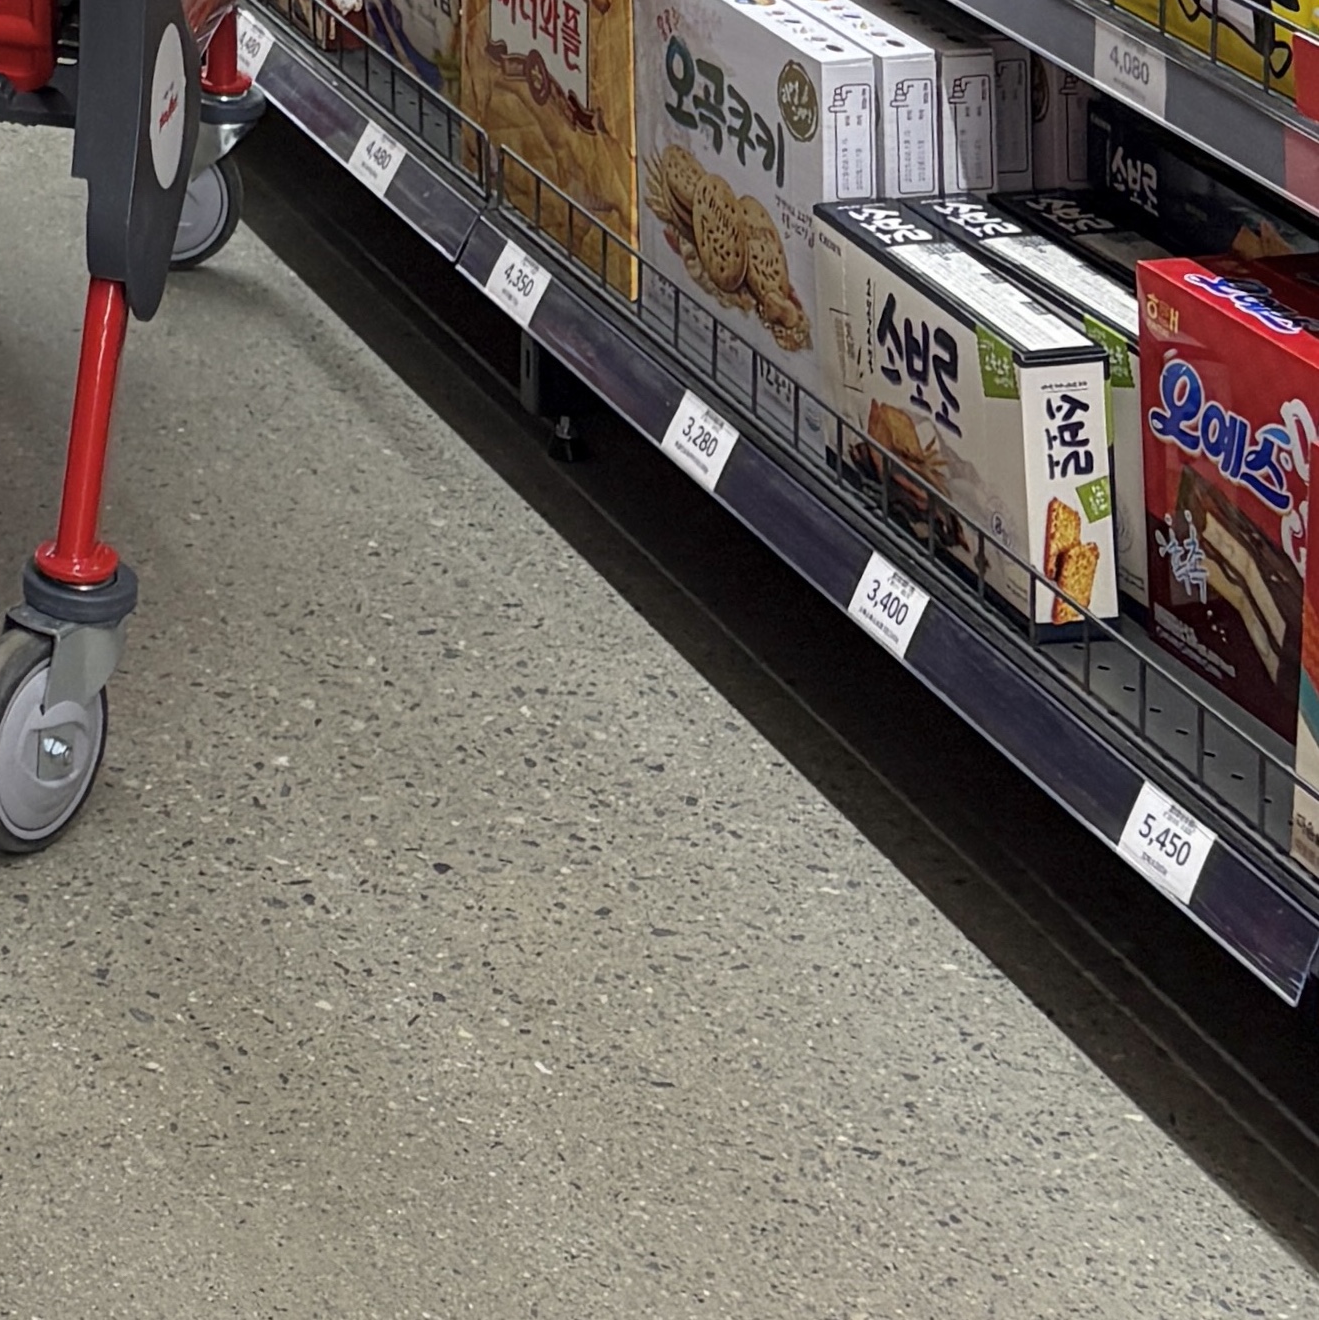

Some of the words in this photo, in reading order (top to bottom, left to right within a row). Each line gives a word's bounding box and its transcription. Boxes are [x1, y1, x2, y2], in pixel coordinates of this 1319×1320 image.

[1108, 43, 1150, 86] 4,080
[663, 34, 788, 189] 오곡쿠키
[365, 137, 394, 171] 4,480
[503, 261, 535, 299] 4,350
[680, 421, 721, 461] 3,280
[1149, 358, 1292, 514] 오예스
[860, 577, 911, 629] 3,400
[1136, 812, 1194, 871] 5,450
